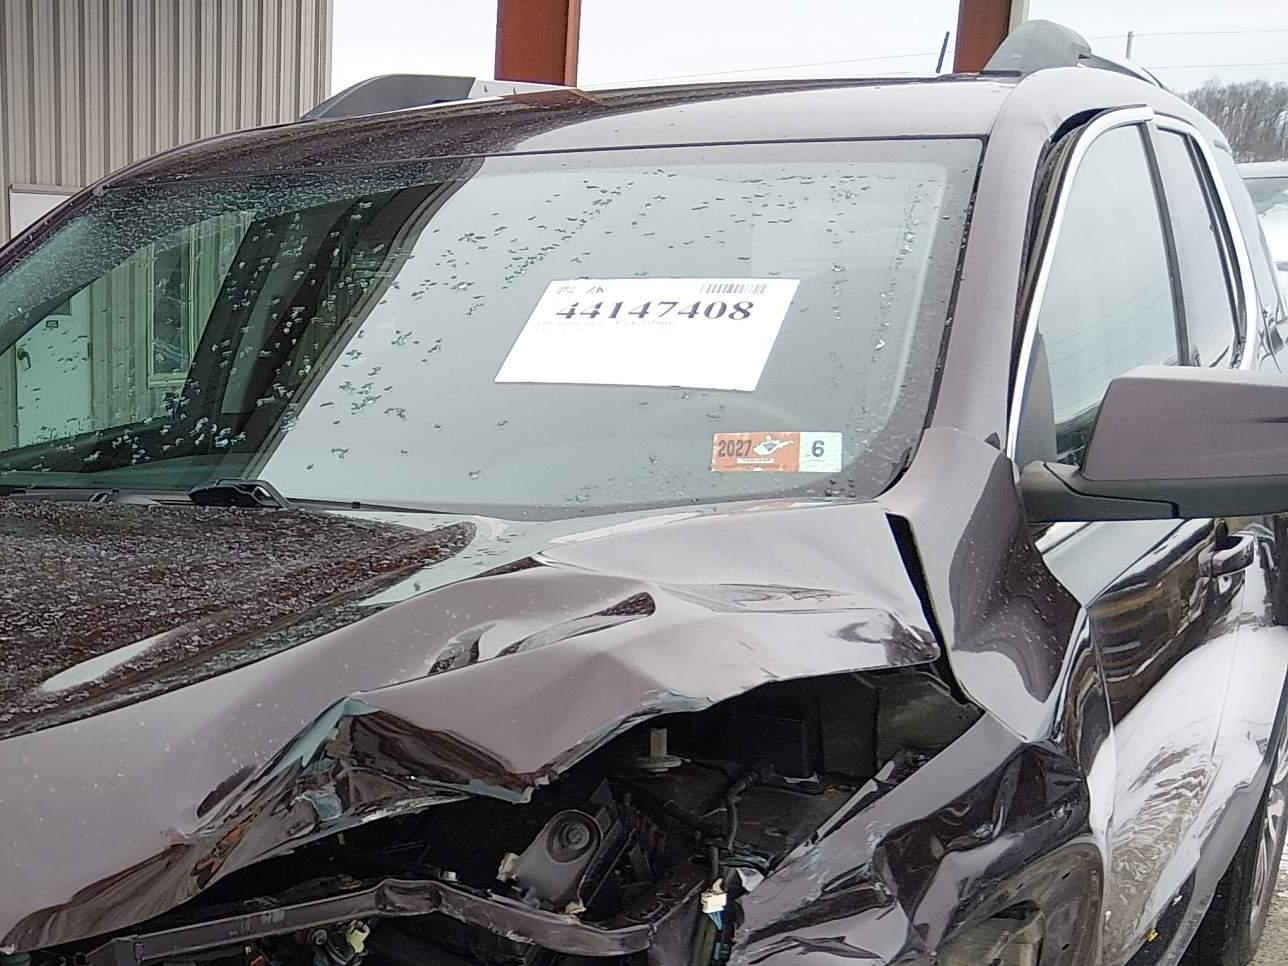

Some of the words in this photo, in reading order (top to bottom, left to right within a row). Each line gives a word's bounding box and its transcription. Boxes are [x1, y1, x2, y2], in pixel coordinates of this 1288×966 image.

[555, 300, 755, 320] 44147408
[717, 439, 753, 457] 2027
[811, 440, 825, 458] 6
